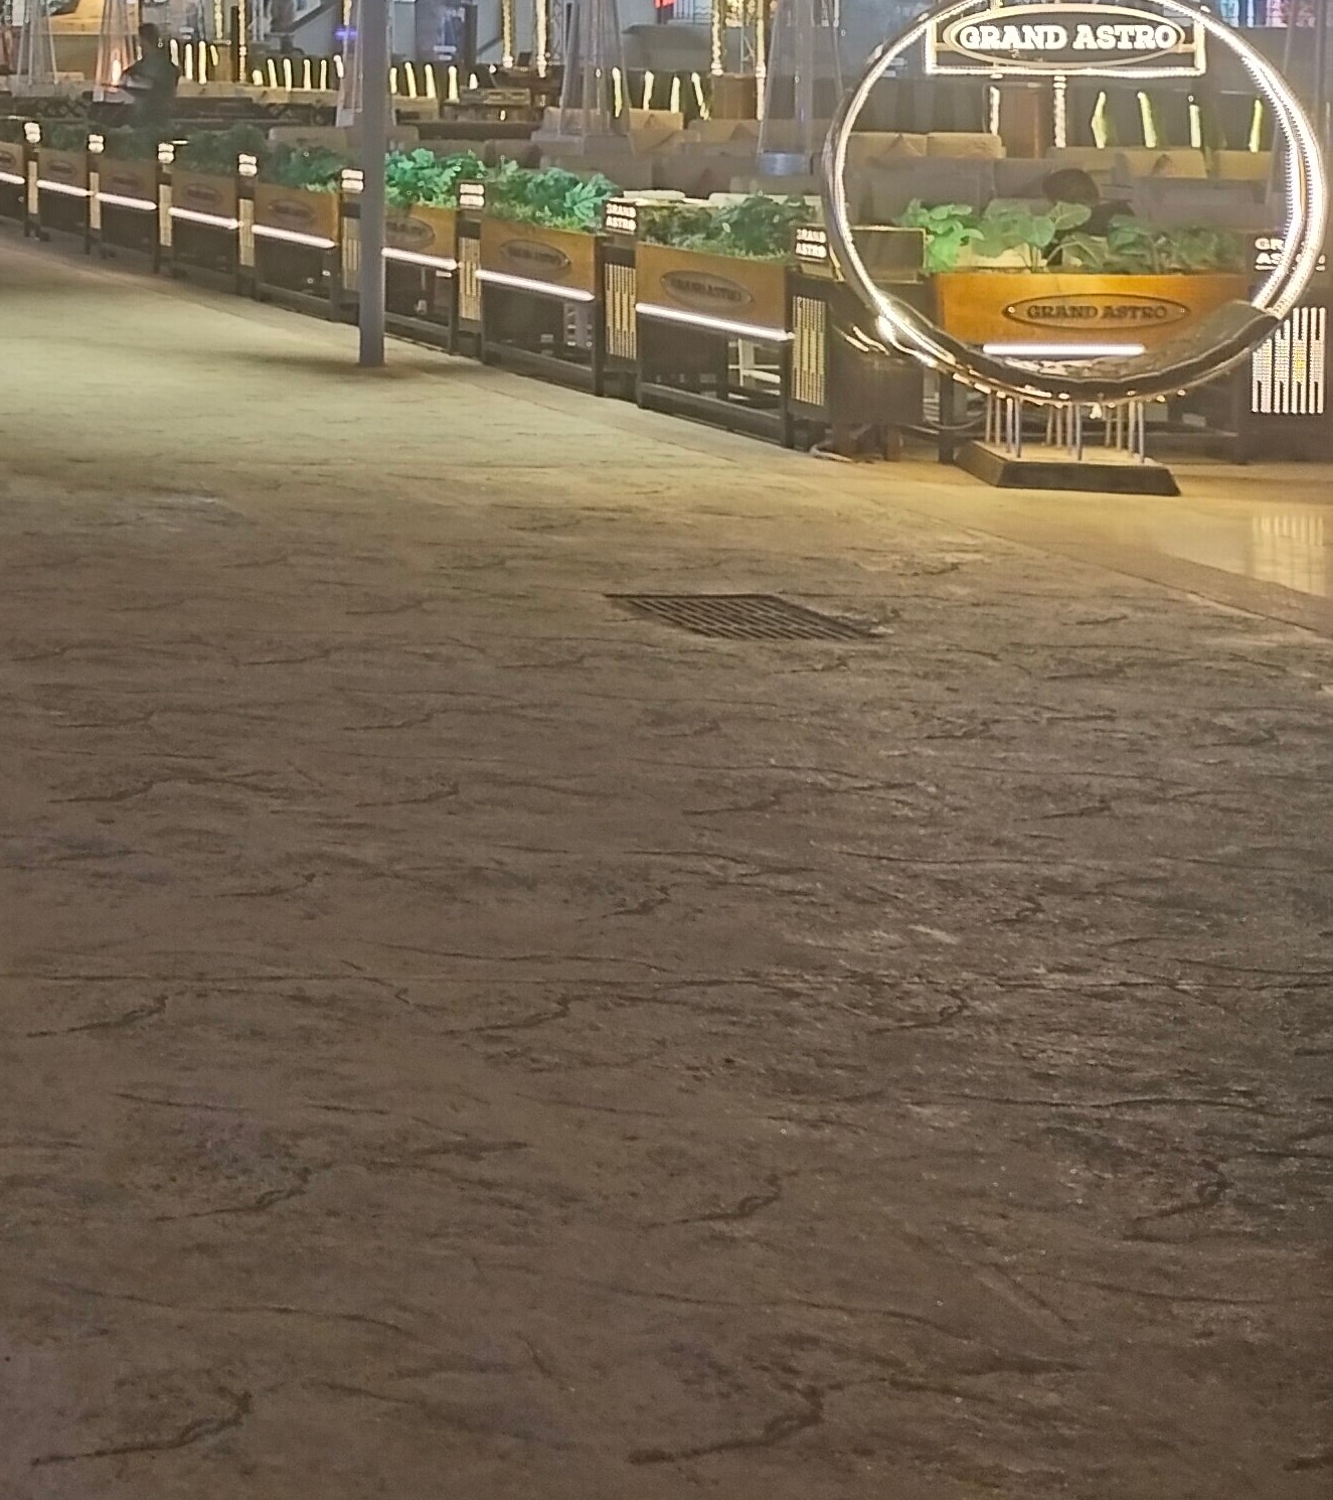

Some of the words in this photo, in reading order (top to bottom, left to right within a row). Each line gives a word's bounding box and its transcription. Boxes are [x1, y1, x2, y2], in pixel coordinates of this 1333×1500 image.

[959, 25, 1067, 50] GRAND
[1072, 25, 1177, 50] ASTRO
[1027, 305, 1098, 319] GRAND
[1101, 305, 1167, 319] ASTRO
